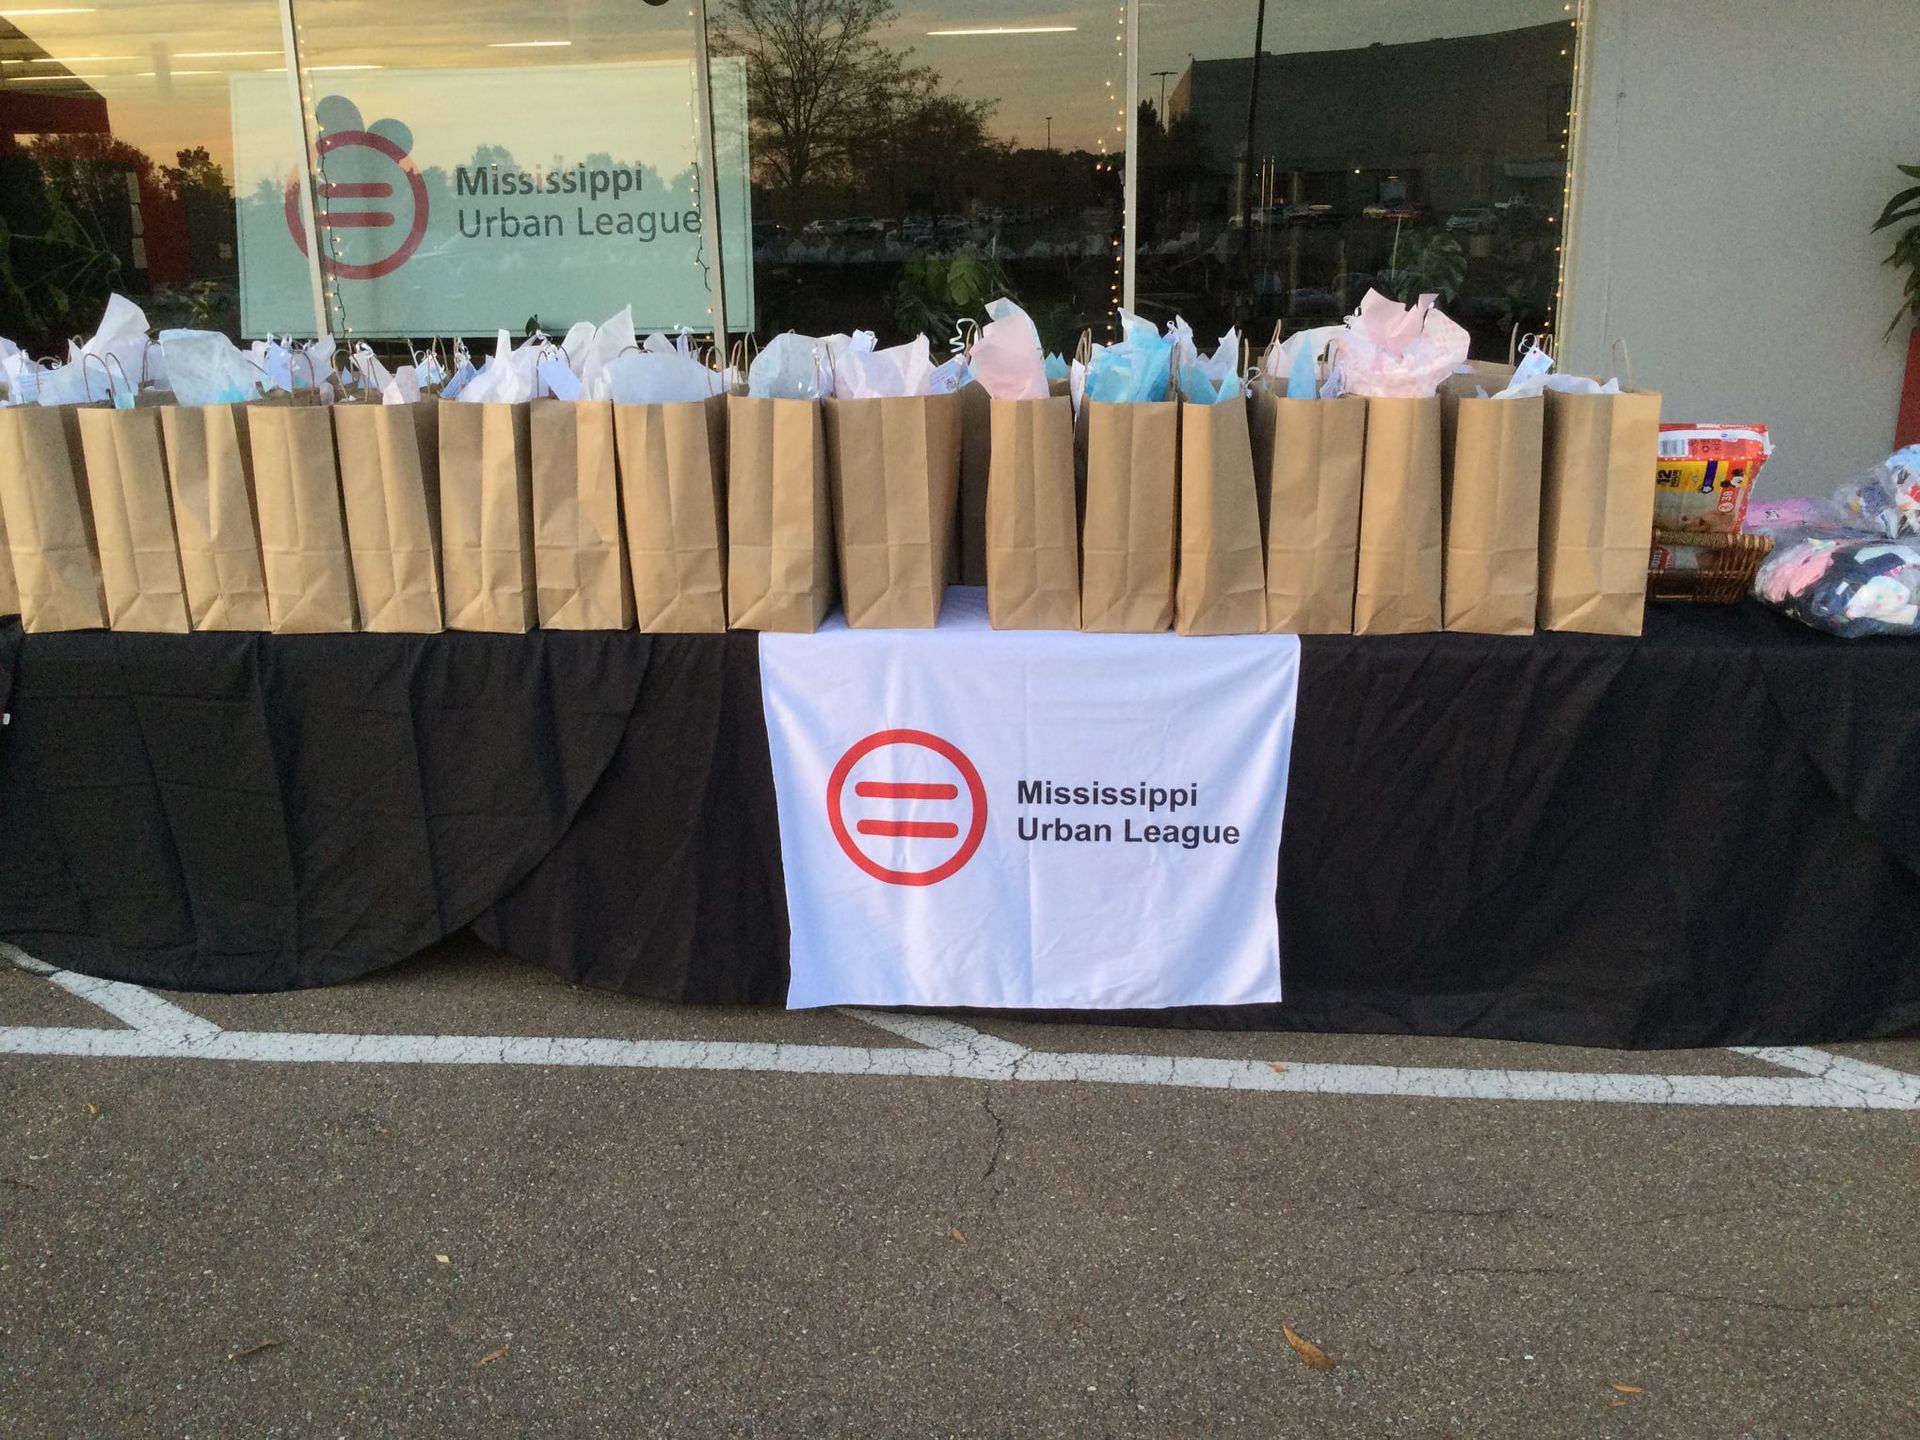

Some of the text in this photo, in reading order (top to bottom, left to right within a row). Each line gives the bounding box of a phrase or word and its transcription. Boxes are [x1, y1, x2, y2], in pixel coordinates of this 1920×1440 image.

[456, 161, 642, 201] Mississippi
[458, 207, 701, 242] Urban League
[1017, 780, 1197, 812] Mississippi
[1017, 817, 1240, 849] Urban League
